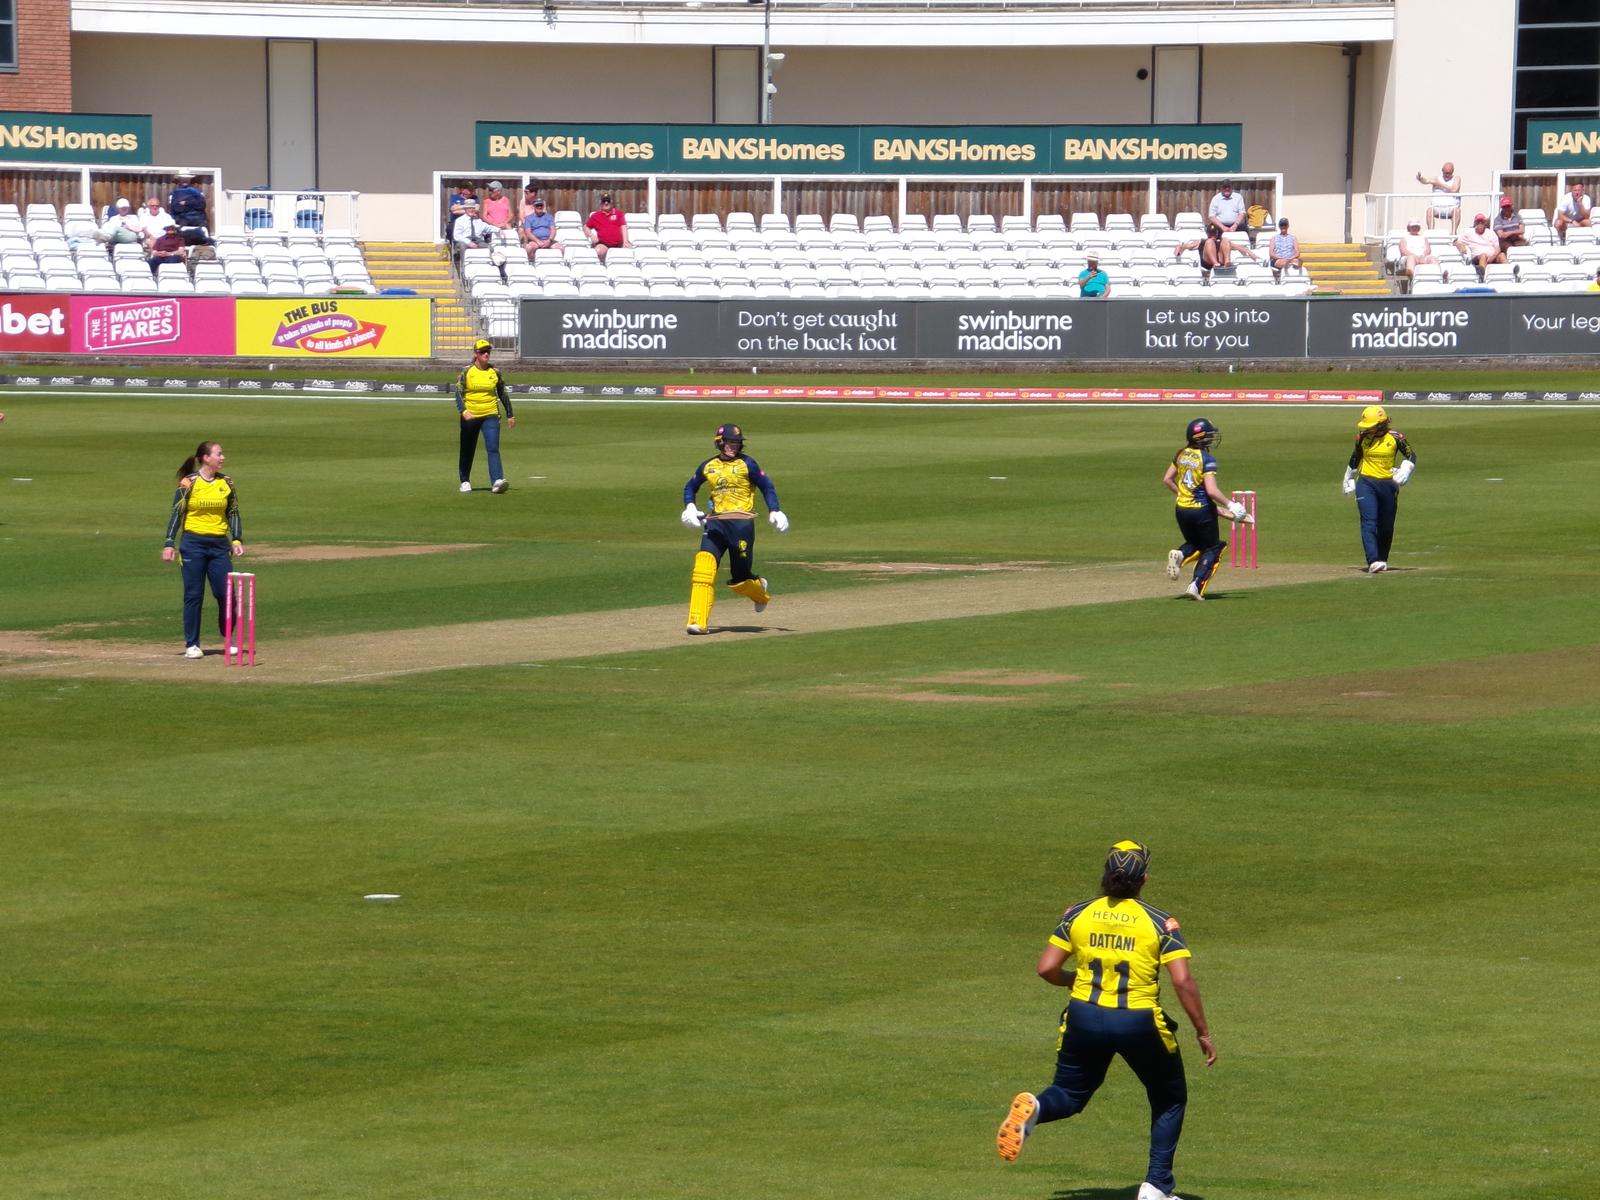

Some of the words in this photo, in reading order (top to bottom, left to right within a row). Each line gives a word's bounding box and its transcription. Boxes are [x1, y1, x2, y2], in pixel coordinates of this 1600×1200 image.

[490, 135, 654, 160] BANKSHomes
[682, 138, 845, 161] BANKSHomes
[874, 138, 1036, 161] BANKSHomes
[1064, 138, 1228, 160] BANKSHomes
[1542, 132, 1600, 154] BAN
[0, 303, 64, 335] bet
[110, 305, 173, 322] MAYOR'S
[284, 306, 309, 323] THE
[311, 301, 338, 315] BUS
[562, 308, 678, 330] swinburne
[793, 312, 825, 330] get
[829, 309, 898, 331] caught
[958, 310, 1072, 331] swinburne
[1146, 309, 1175, 324] Let
[1180, 312, 1200, 324] us
[1205, 311, 1230, 328] go
[1235, 308, 1270, 323] into
[1352, 307, 1469, 328] swinburne
[1522, 314, 1566, 329] Your
[92, 318, 100, 338] THE
[111, 318, 173, 341] FARES
[1352, 328, 1457, 348] maddison
[562, 329, 666, 350] maddison
[738, 338, 762, 350] on
[768, 335, 798, 350] the
[804, 333, 852, 350] back
[859, 332, 897, 350] foot
[958, 330, 1062, 350] maddison
[1146, 330, 1178, 348] bat
[1185, 332, 1210, 347] for
[1215, 335, 1249, 351] you
[1183, 469, 1194, 488] 4
[1093, 910, 1139, 924] HENDY
[1090, 932, 1135, 951] DATTANI
[1088, 958, 1130, 1008] 11
